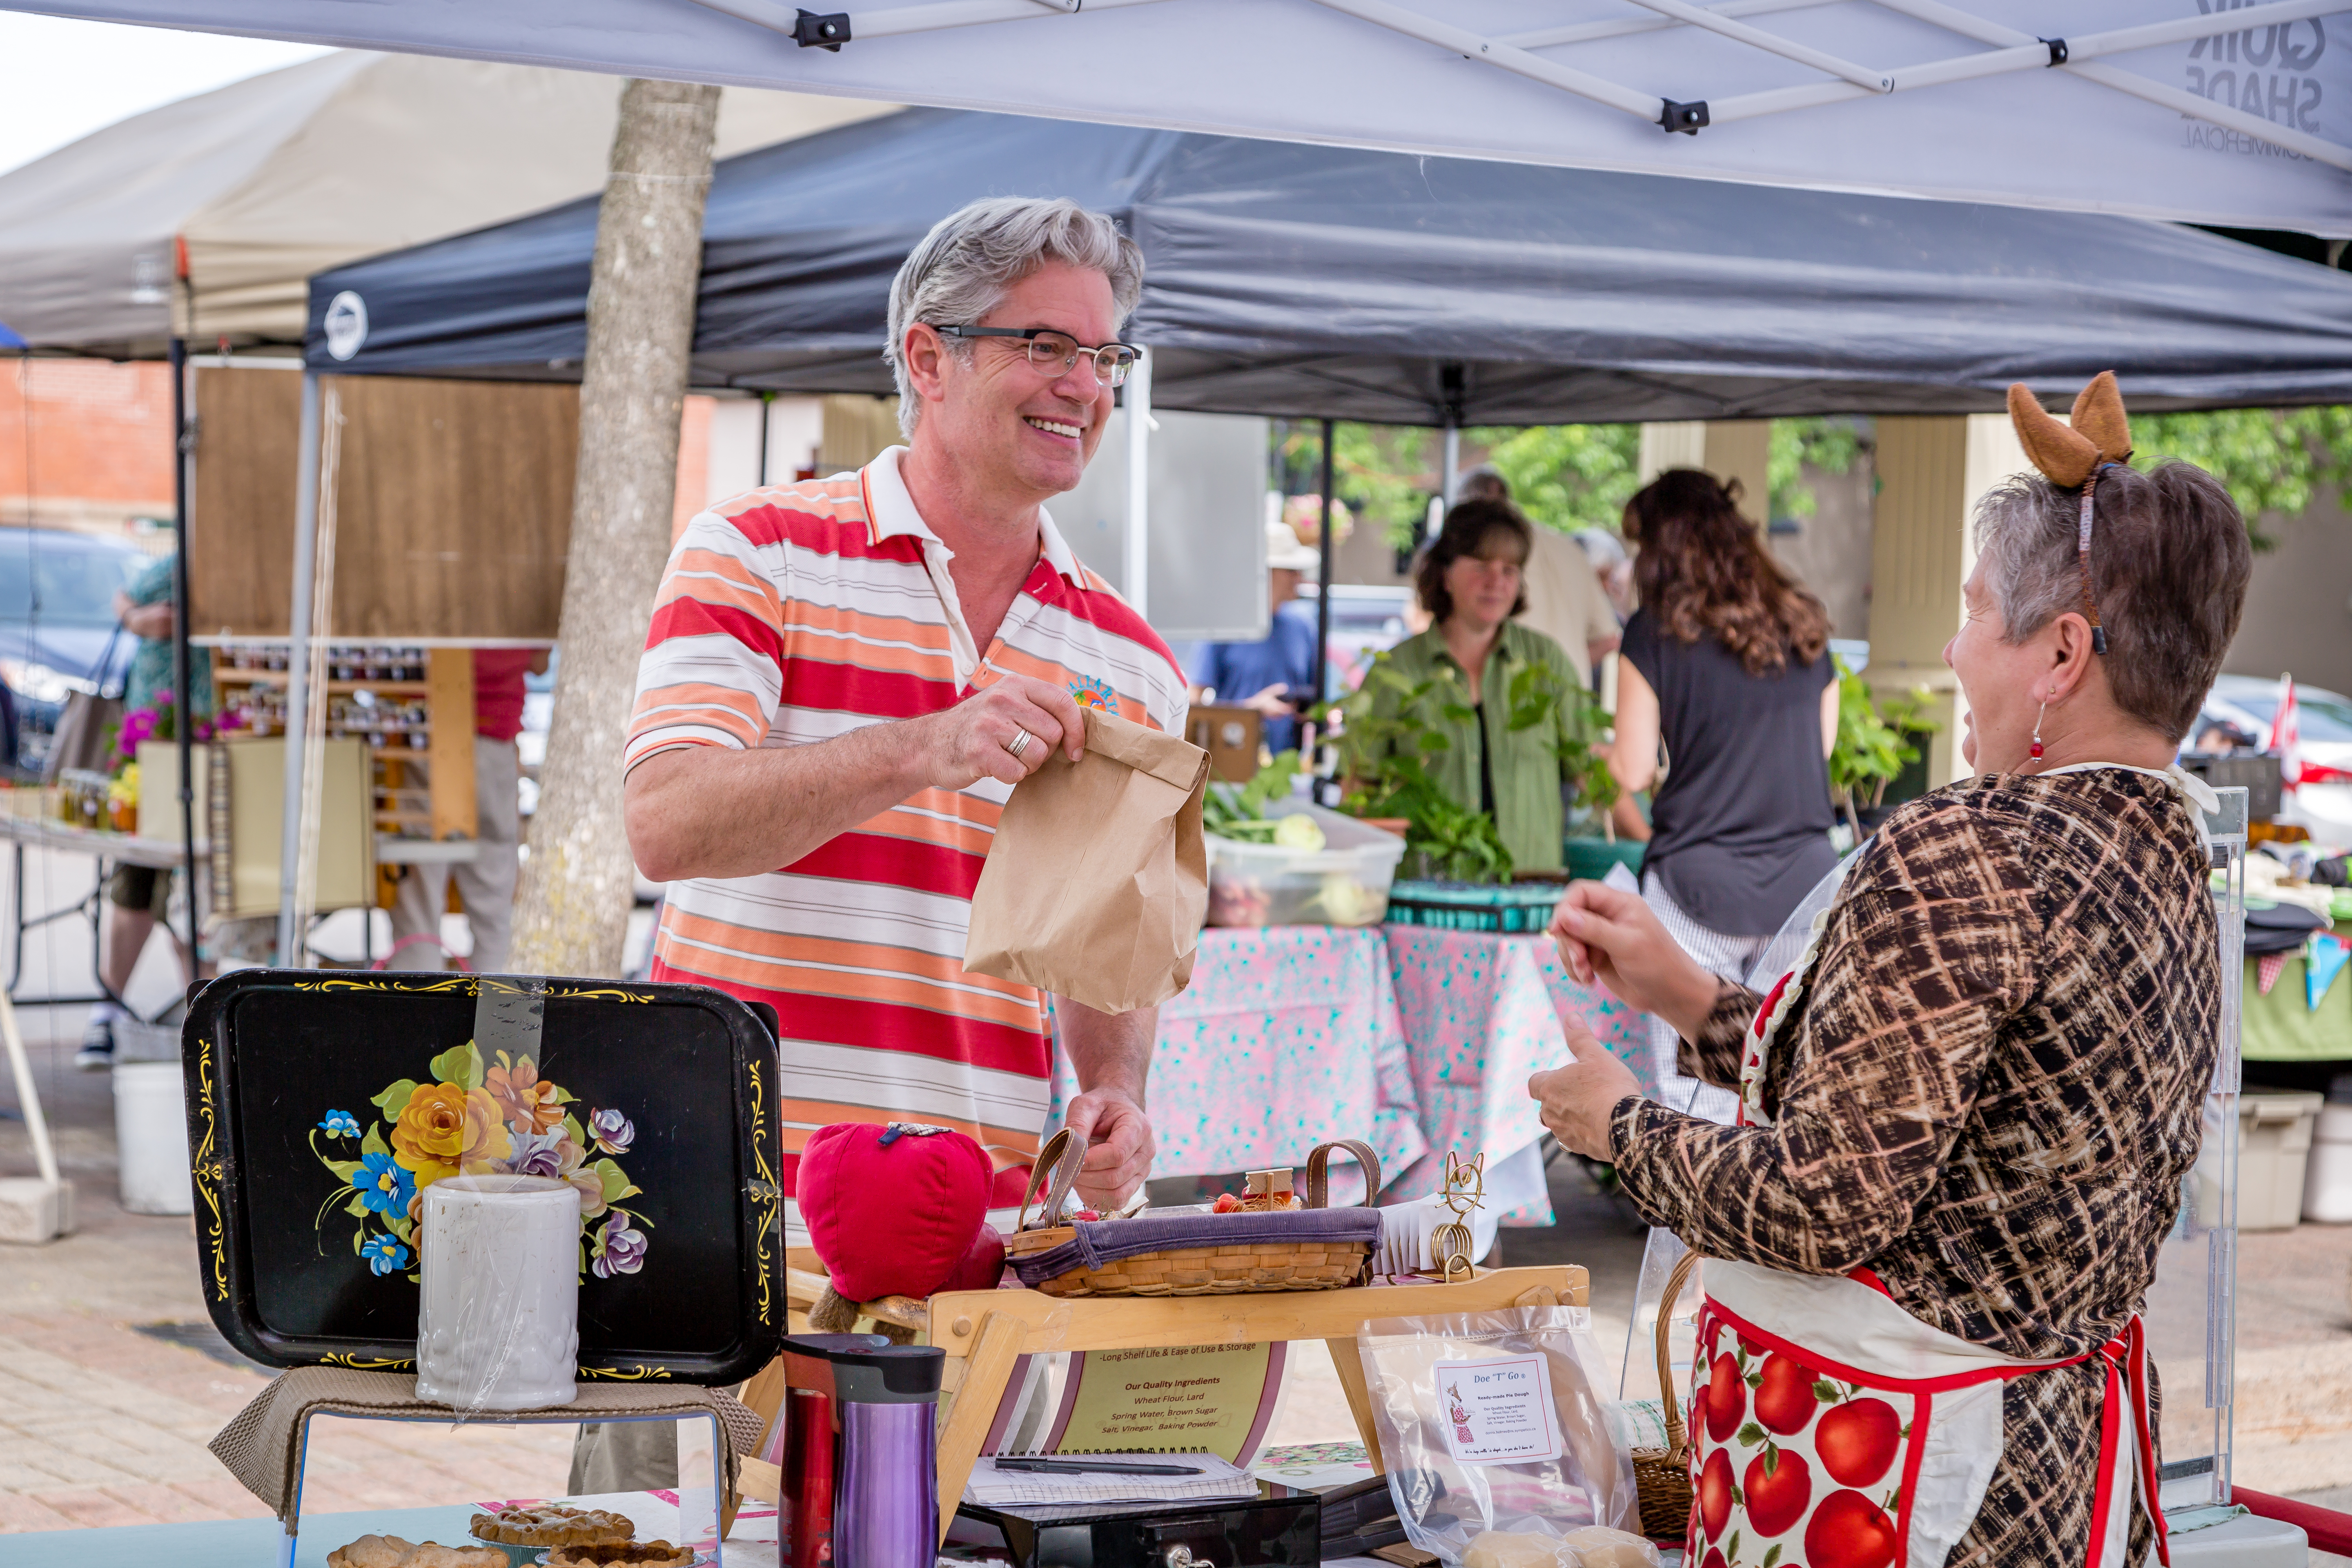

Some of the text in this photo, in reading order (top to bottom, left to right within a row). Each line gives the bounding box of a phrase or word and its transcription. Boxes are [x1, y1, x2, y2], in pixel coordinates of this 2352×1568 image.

[1123, 1350, 1145, 1360] Shelf
[1146, 1349, 1160, 1358] Life
[1191, 1346, 1200, 1354] of
[1218, 1344, 1224, 1352] &
[1226, 1343, 1256, 1351] Storage
[1508, 1372, 1519, 1380] Go
[1143, 1381, 1173, 1390] Quality
[1174, 1377, 1220, 1387] Ingredients
[1187, 1392, 1205, 1401] Lard
[1111, 1413, 1137, 1421] Spring
